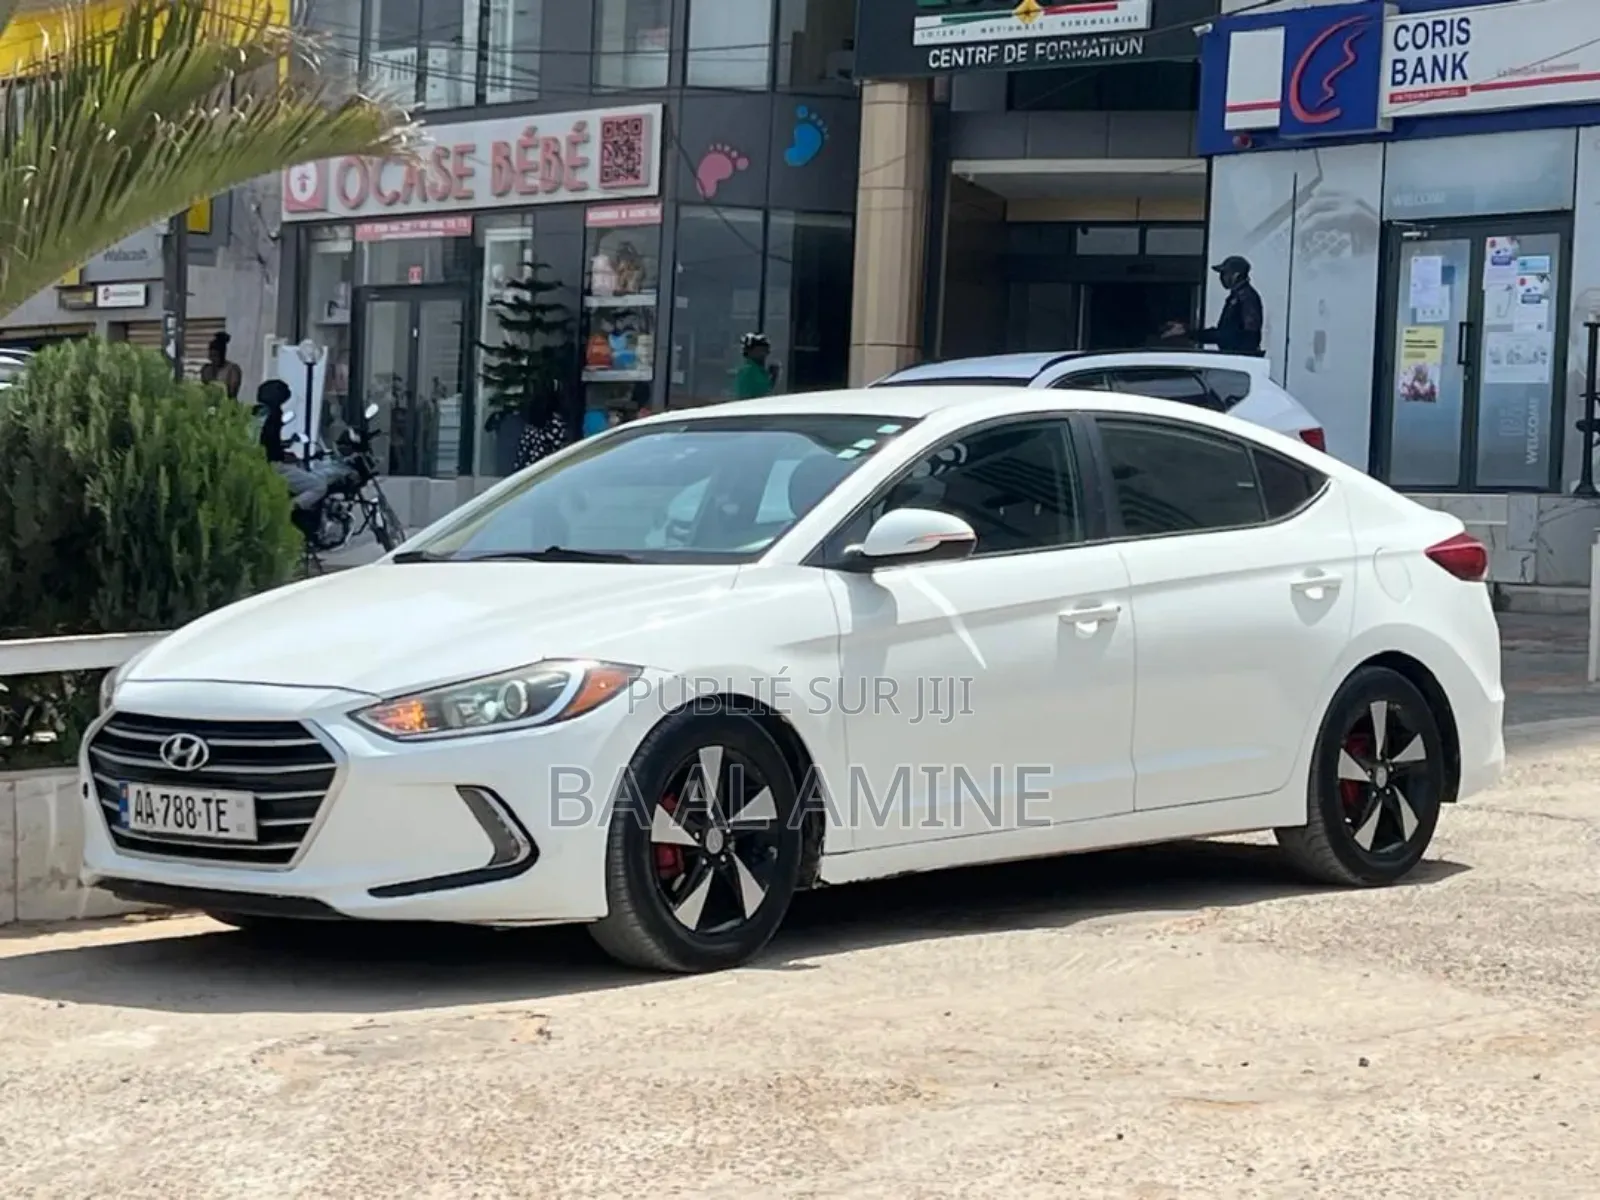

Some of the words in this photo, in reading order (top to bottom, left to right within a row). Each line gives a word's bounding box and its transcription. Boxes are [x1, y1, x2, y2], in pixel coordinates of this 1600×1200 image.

[1004, 43, 1028, 64] DE
[1034, 36, 1143, 60] FORMATION
[1393, 17, 1471, 52] CORIS
[1391, 51, 1469, 86] BANK
[335, 143, 477, 209] OCASE
[490, 120, 590, 198] BÉBÉ
